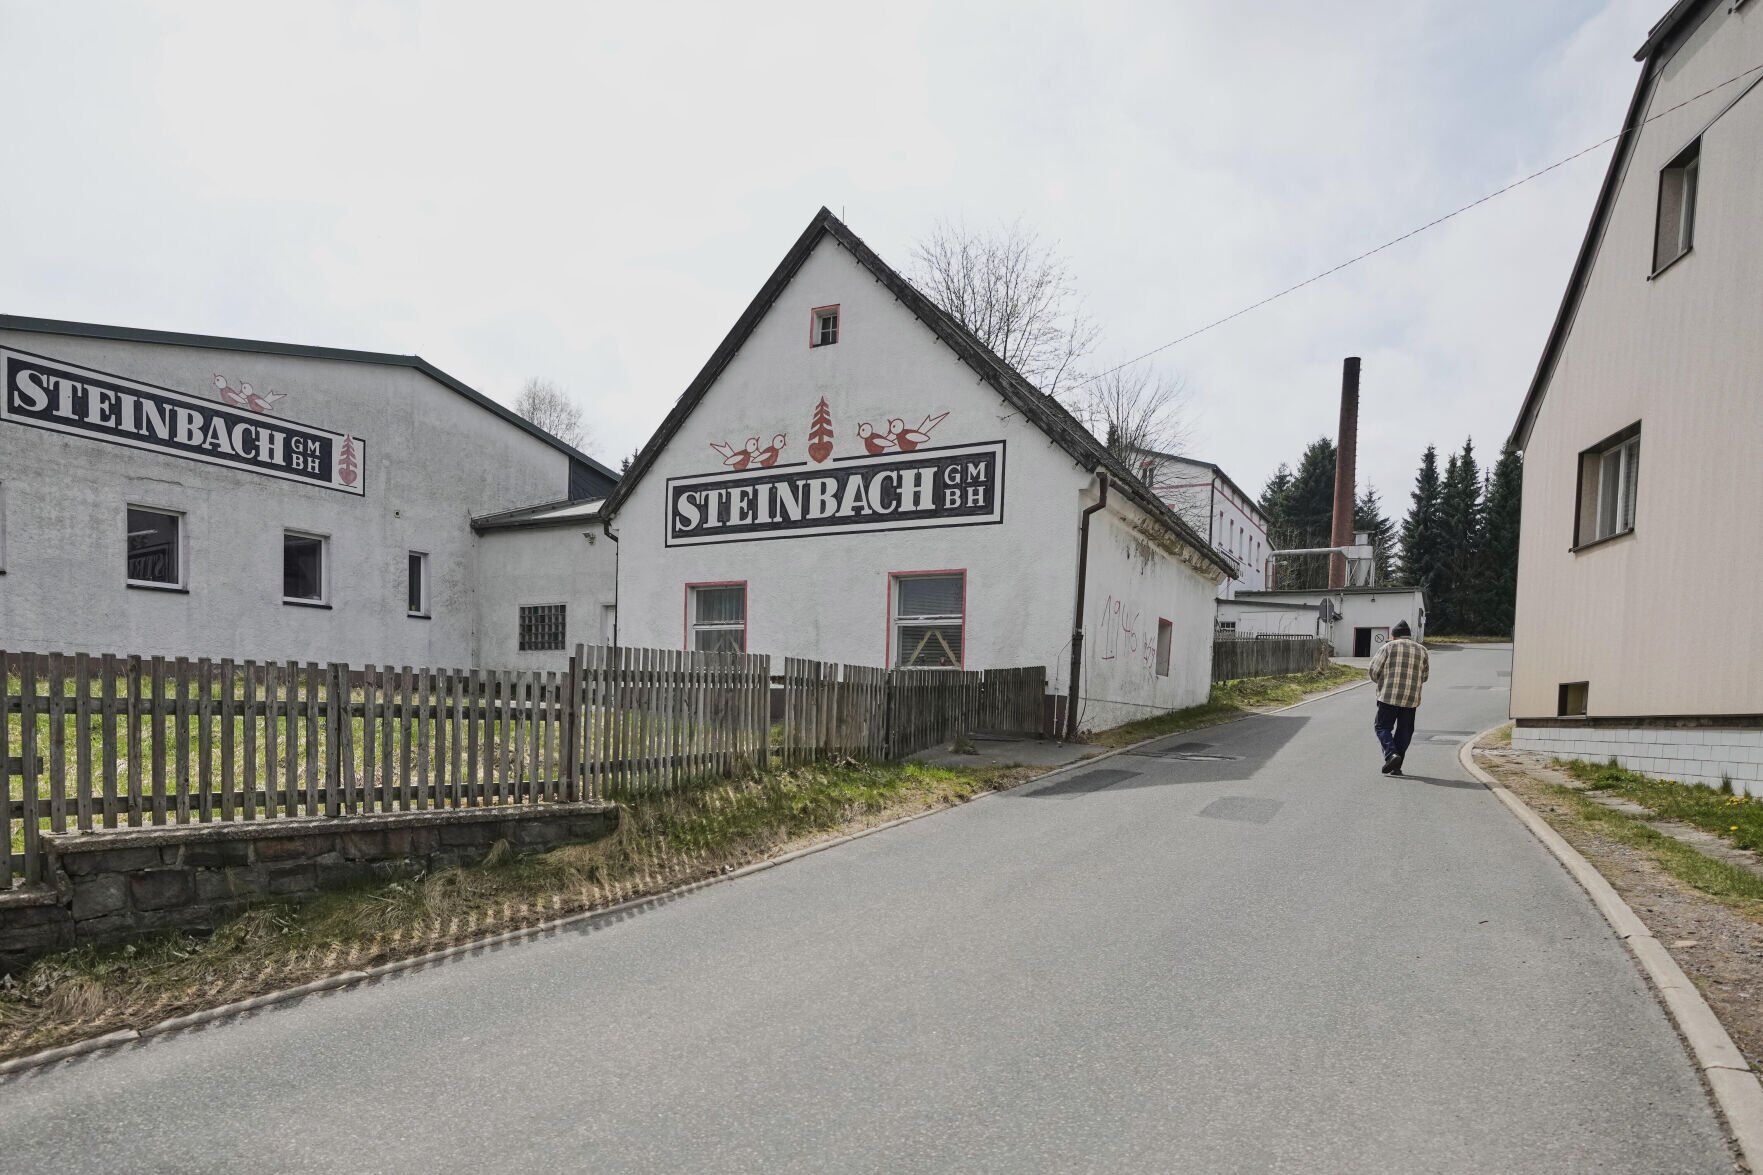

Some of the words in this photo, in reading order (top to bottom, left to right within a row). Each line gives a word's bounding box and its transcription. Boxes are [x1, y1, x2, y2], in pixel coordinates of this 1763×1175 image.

[14, 369, 287, 466] STEINBACH
[292, 437, 321, 456] GM
[292, 455, 321, 473] BH
[943, 462, 988, 485] GM
[676, 467, 939, 532] STEINBACH
[943, 486, 987, 509] BH
